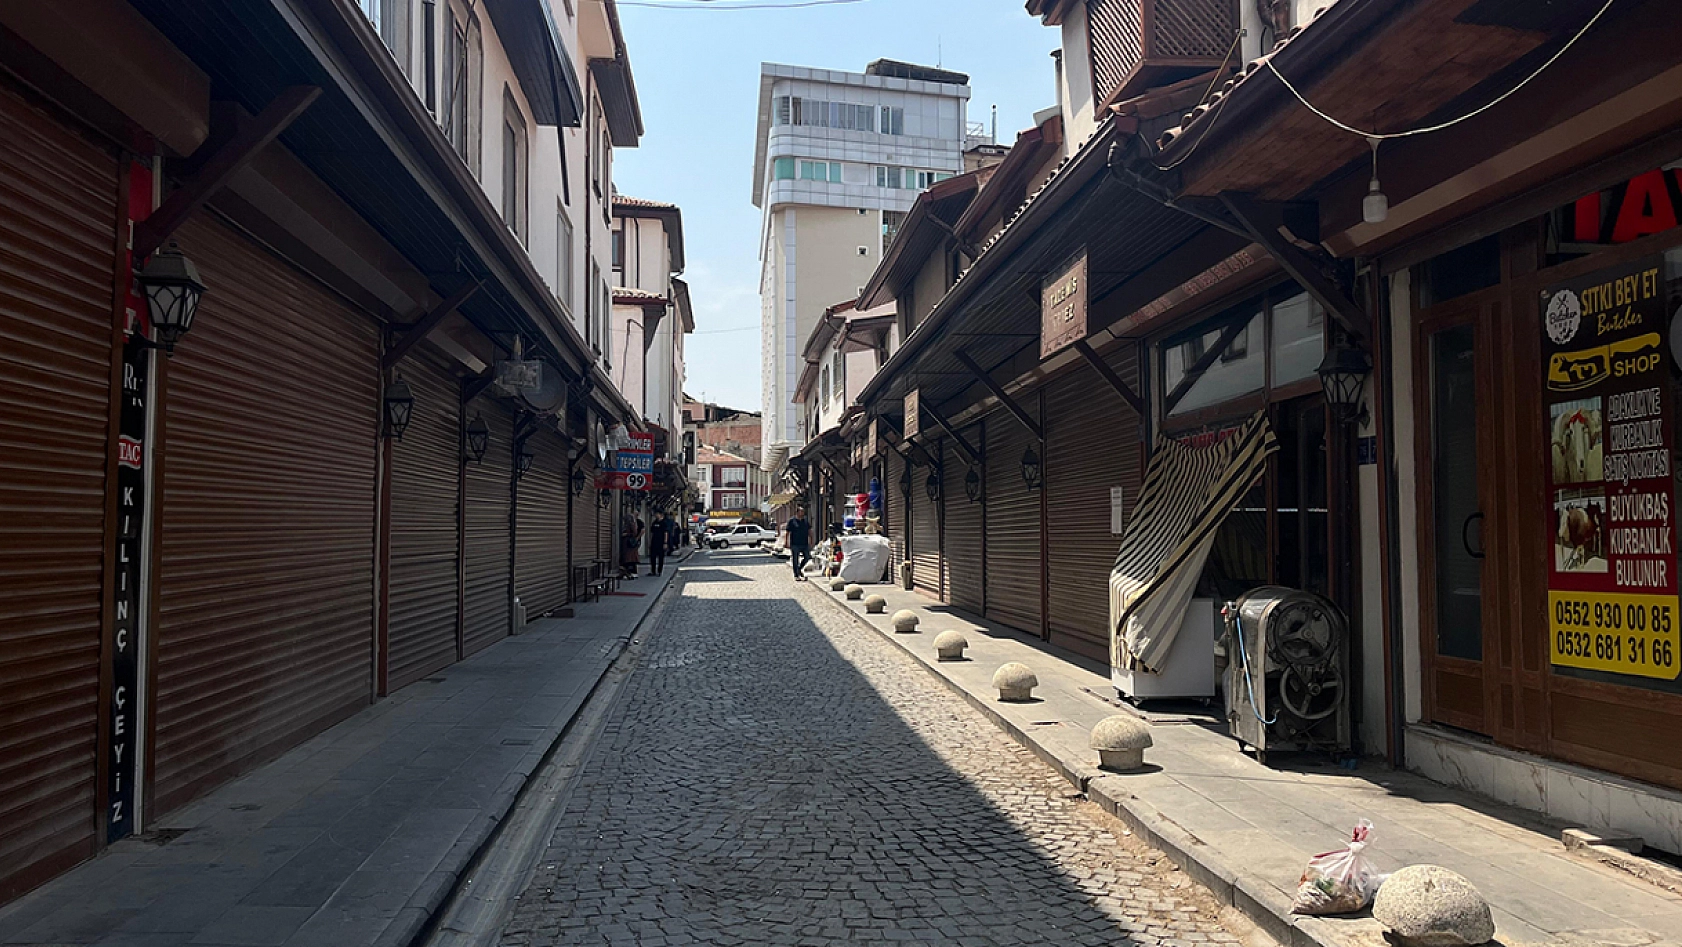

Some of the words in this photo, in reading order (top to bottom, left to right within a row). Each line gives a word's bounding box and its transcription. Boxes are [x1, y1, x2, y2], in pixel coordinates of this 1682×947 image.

[1581, 282, 1613, 317] SITKI
[1615, 272, 1639, 307] BEY
[1642, 268, 1658, 299] ET
[1597, 305, 1643, 336] Butcher
[1613, 353, 1661, 378] SHOP
[1610, 418, 1663, 451] KURBANLIK
[629, 475, 643, 487] 99
[1609, 488, 1669, 526] BÜYÜKBAŞ
[1609, 526, 1672, 555] KURBANLIK
[117, 486, 133, 653] KILINÇ
[1615, 559, 1668, 588] BULUNUR
[1556, 600, 1590, 626] 0552
[1594, 602, 1622, 629] 930
[1627, 604, 1646, 631] 00
[1651, 605, 1671, 633] 85
[1557, 630, 1591, 657] 0532
[1596, 634, 1622, 661] 681
[1627, 636, 1646, 664] 31
[1652, 638, 1672, 667] 66
[112, 685, 126, 823] ÇEYİZ
